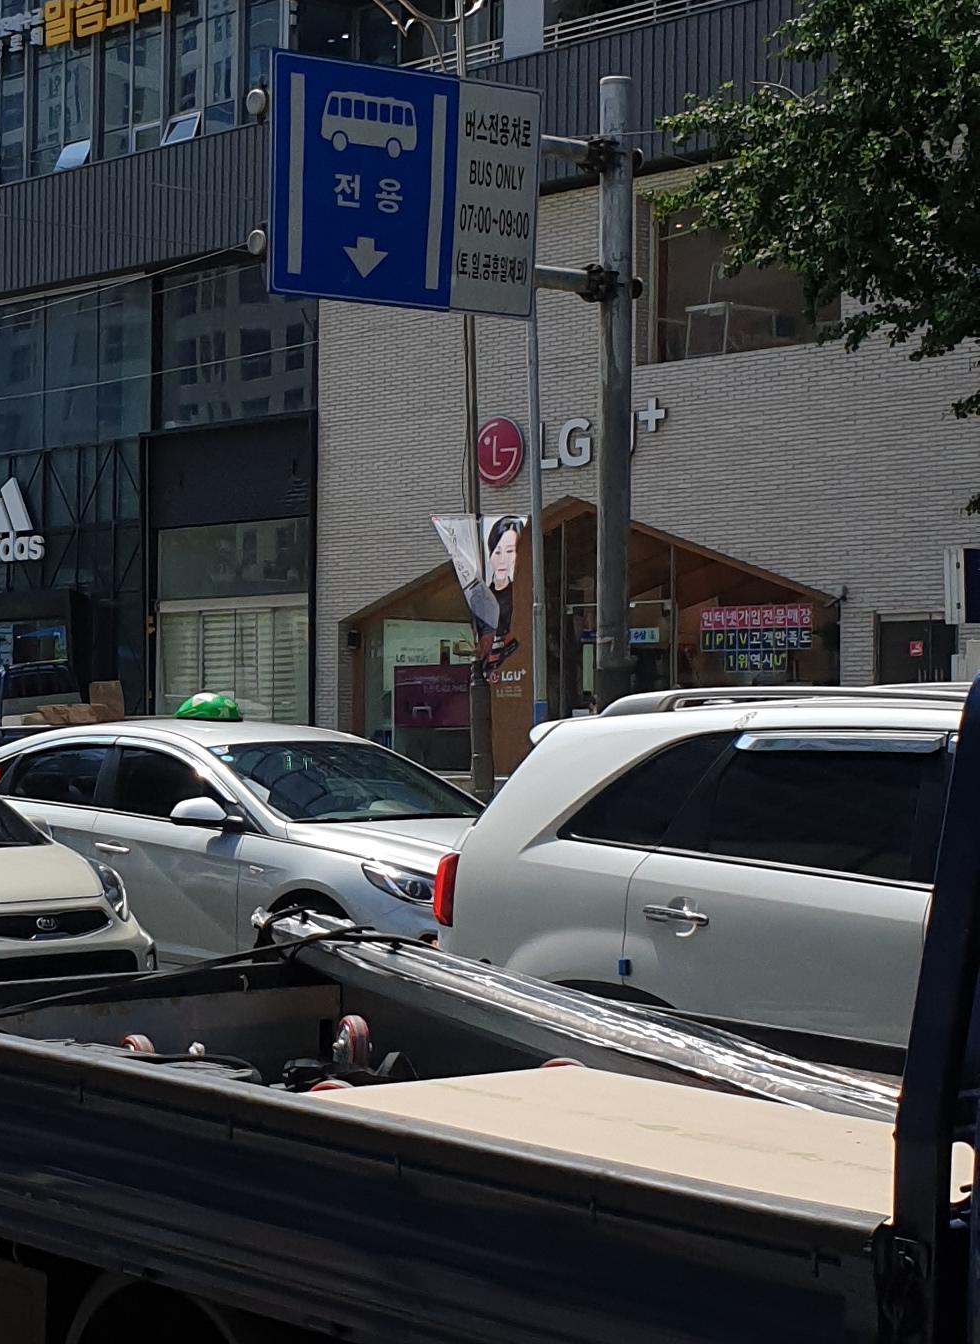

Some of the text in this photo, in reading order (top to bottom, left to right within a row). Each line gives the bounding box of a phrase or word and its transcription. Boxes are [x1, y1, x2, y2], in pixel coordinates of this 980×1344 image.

[465, 112, 532, 149] 버스전용차로
[469, 160, 525, 191] BUS ONLY
[460, 204, 530, 240] 07:00~09:00
